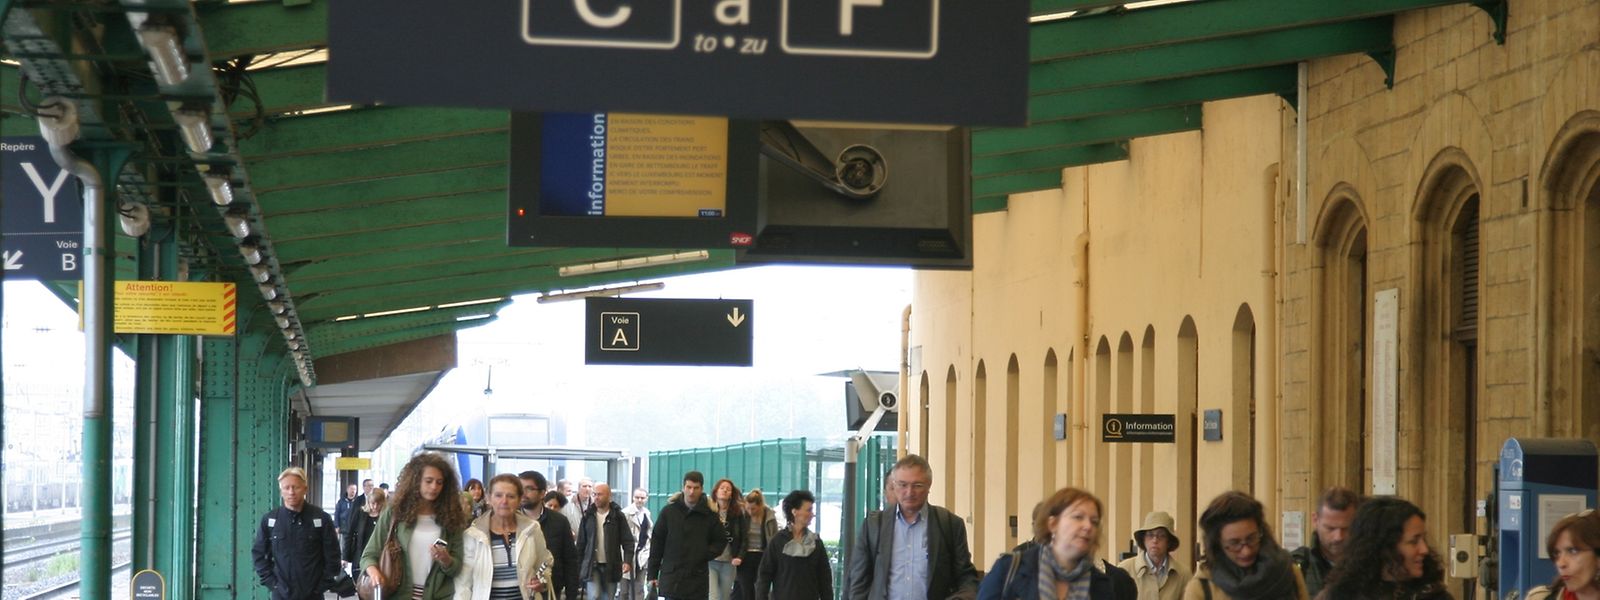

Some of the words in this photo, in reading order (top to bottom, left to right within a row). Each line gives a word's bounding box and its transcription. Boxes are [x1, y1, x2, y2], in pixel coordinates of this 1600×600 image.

[694, 33, 716, 52] to
[740, 36, 768, 54] zu
[0, 143, 35, 152] Repère
[588, 113, 605, 215] information
[20, 162, 69, 223] Y
[56, 240, 78, 249] Voie
[731, 236, 752, 244] SNCF
[62, 253, 76, 271] B
[611, 316, 630, 324] Voie
[611, 328, 629, 346] A
[1126, 422, 1173, 430] Information
